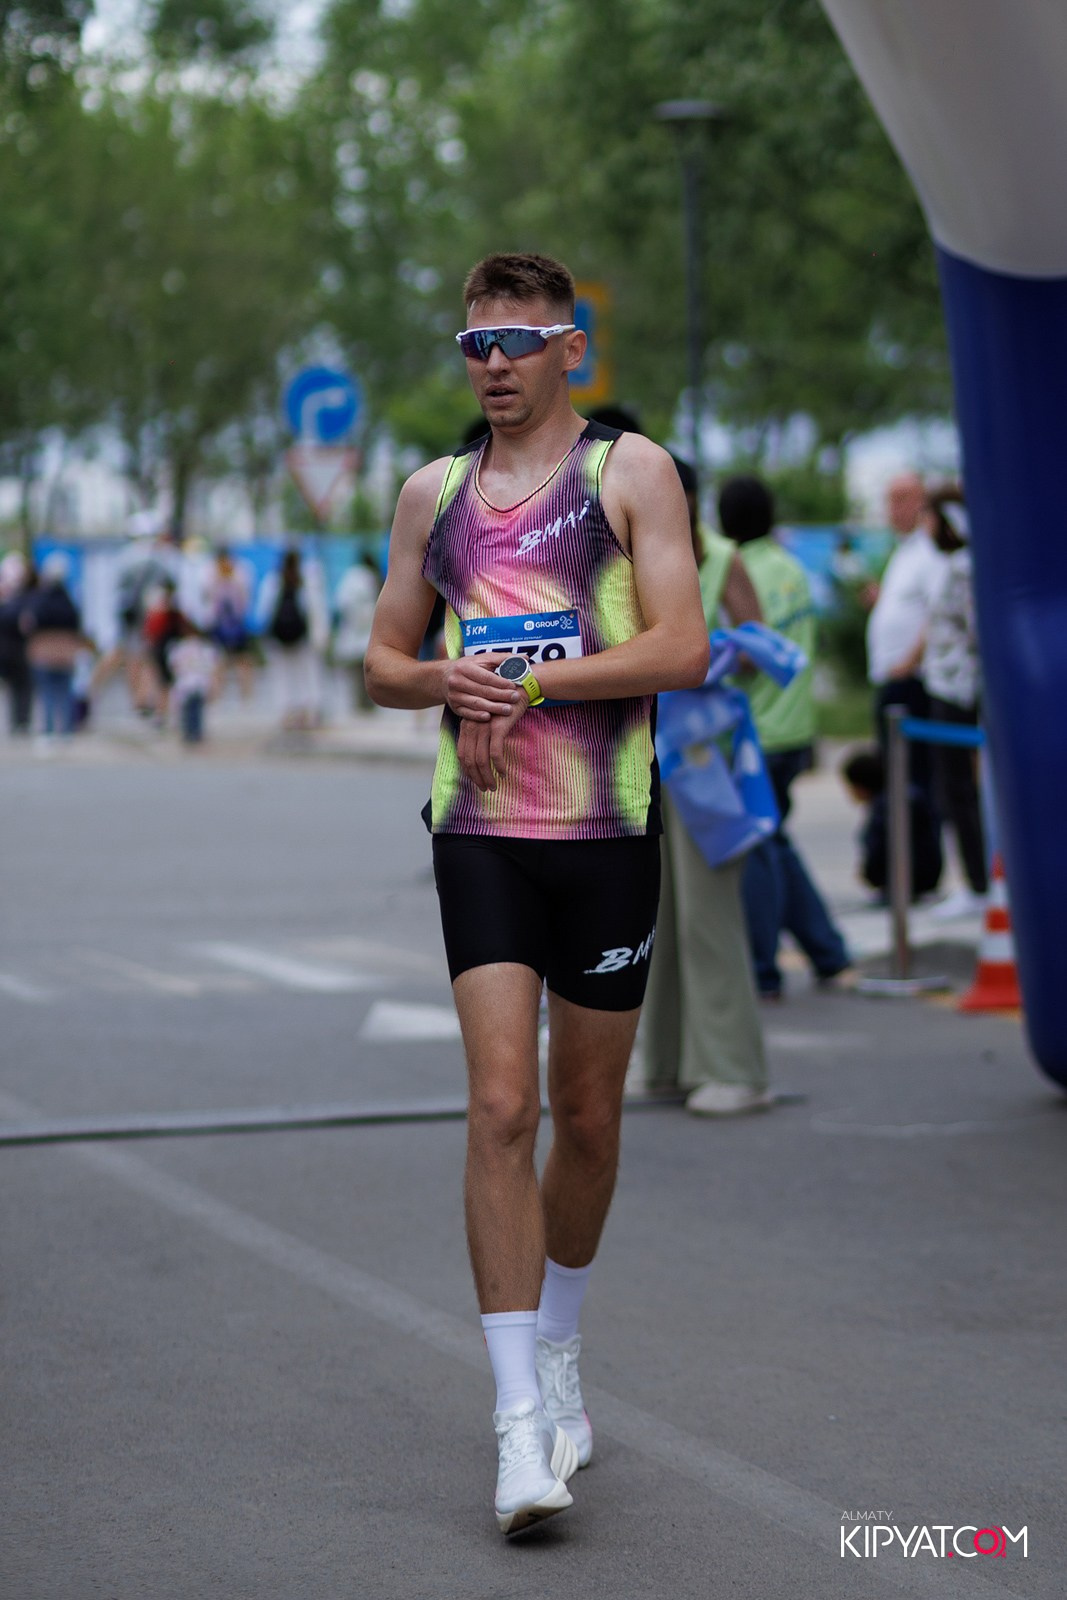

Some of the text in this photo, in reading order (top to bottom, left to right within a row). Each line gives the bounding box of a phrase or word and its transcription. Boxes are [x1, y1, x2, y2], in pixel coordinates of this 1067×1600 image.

[535, 620, 560, 629] GROUP
[465, 624, 487, 637] 5 KM
